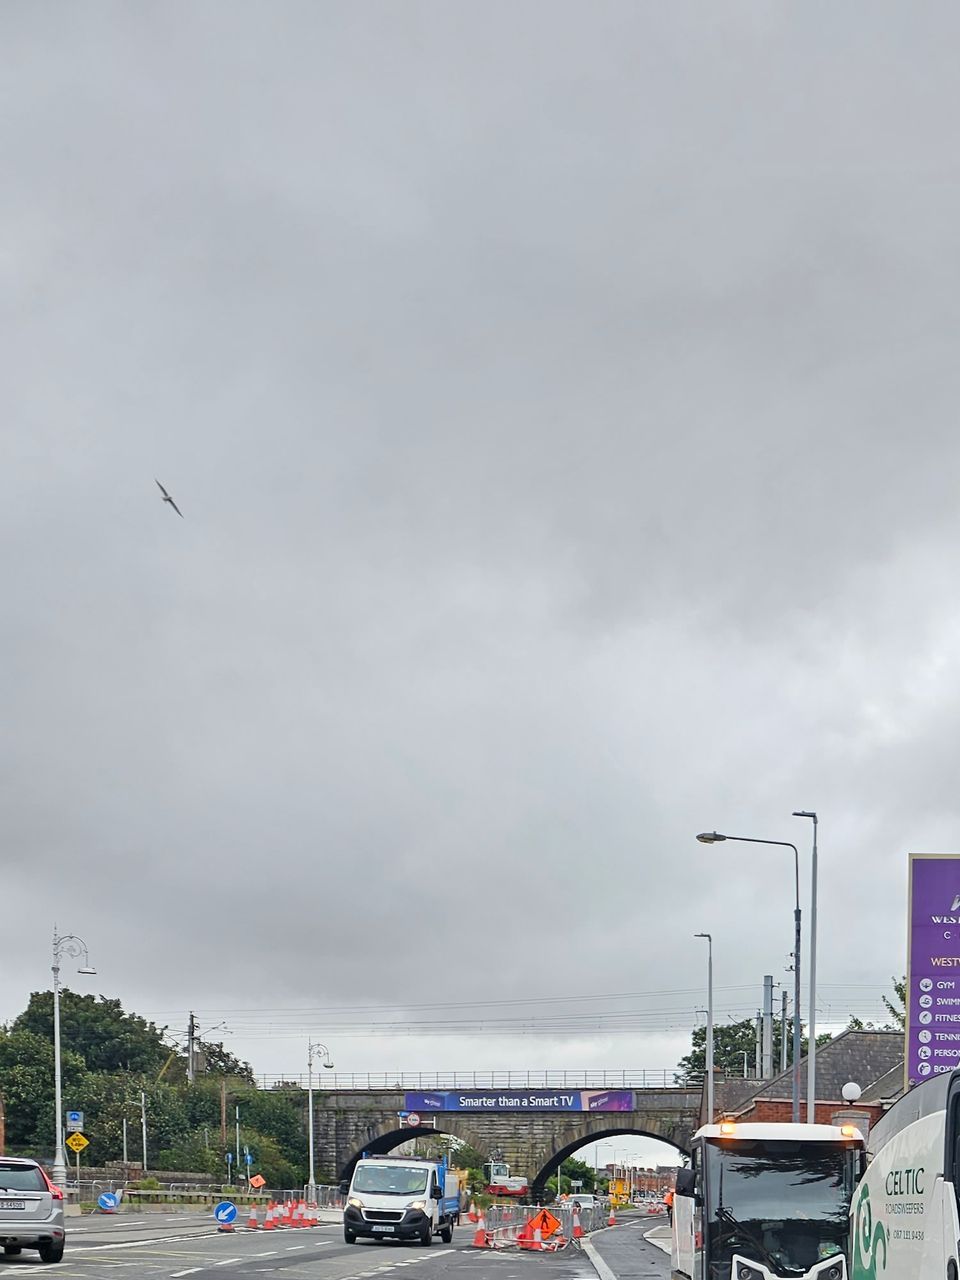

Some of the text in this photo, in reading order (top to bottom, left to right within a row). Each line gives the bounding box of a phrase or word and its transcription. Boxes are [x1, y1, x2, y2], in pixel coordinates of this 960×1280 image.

[936, 981, 955, 989] GYM
[459, 1096, 573, 1107] Smarter than a Smart TV
[885, 1167, 925, 1196] CELTIC
[885, 1202, 924, 1215] ROADSWEEPERS
